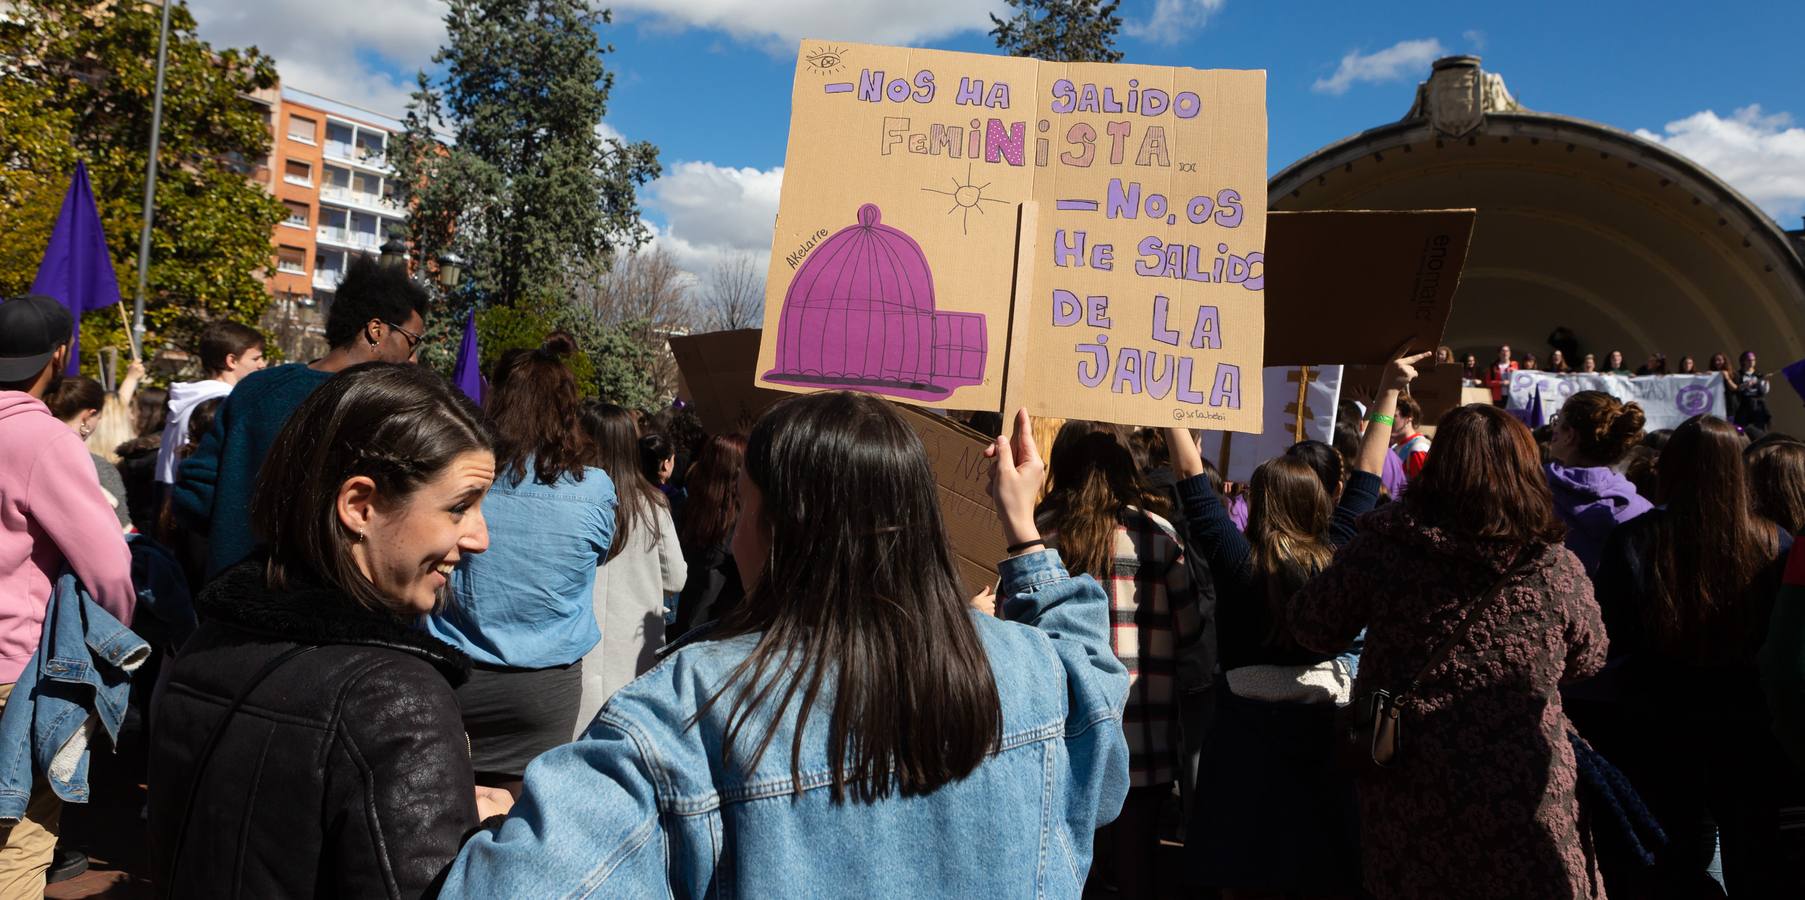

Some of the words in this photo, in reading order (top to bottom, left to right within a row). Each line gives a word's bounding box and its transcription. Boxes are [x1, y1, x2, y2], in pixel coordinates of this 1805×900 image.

[956, 77, 1010, 109] HA
[1186, 189, 1244, 228] OS
[1054, 230, 1114, 271] HE
[1052, 289, 1111, 329] DE
[1152, 294, 1222, 349] LA
